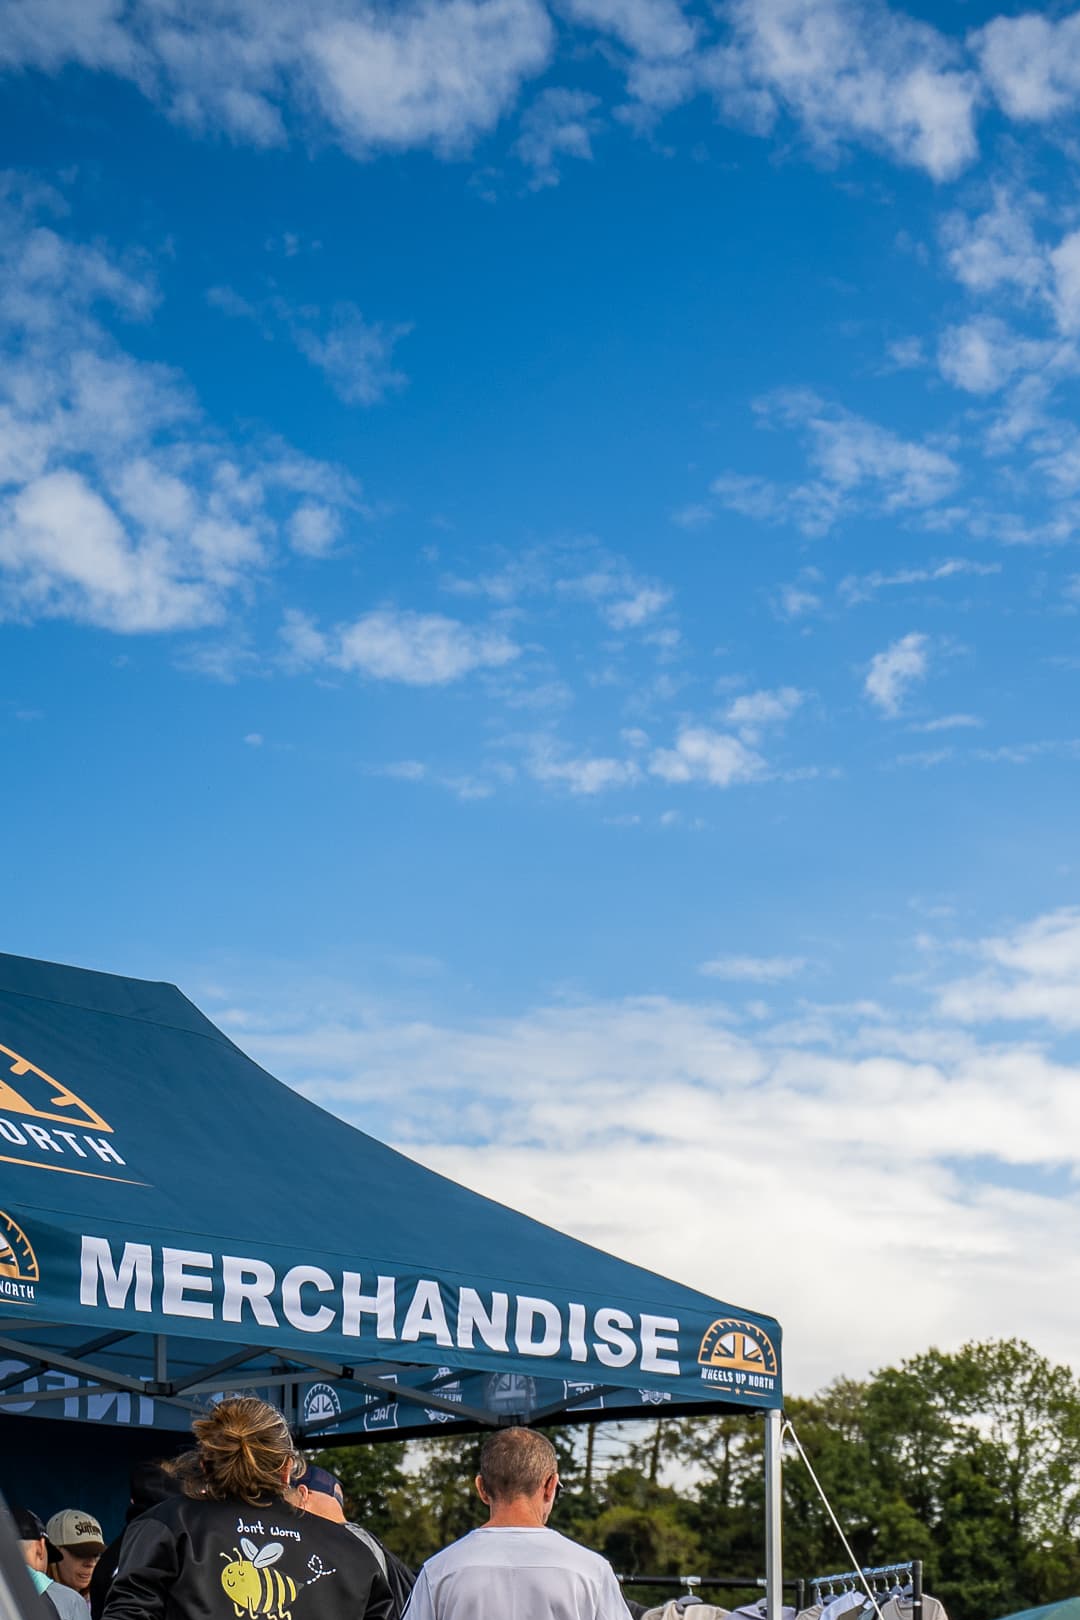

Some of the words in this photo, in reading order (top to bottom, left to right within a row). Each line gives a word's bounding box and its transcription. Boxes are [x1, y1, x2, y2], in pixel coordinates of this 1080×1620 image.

[0, 1118, 127, 1166] ORTH
[80, 1235, 682, 1375] MERCHANDISE
[700, 1367, 733, 1383] WHEELS
[735, 1372, 747, 1385] UP
[748, 1375, 775, 1390] NORTH
[236, 1518, 265, 1535] don't
